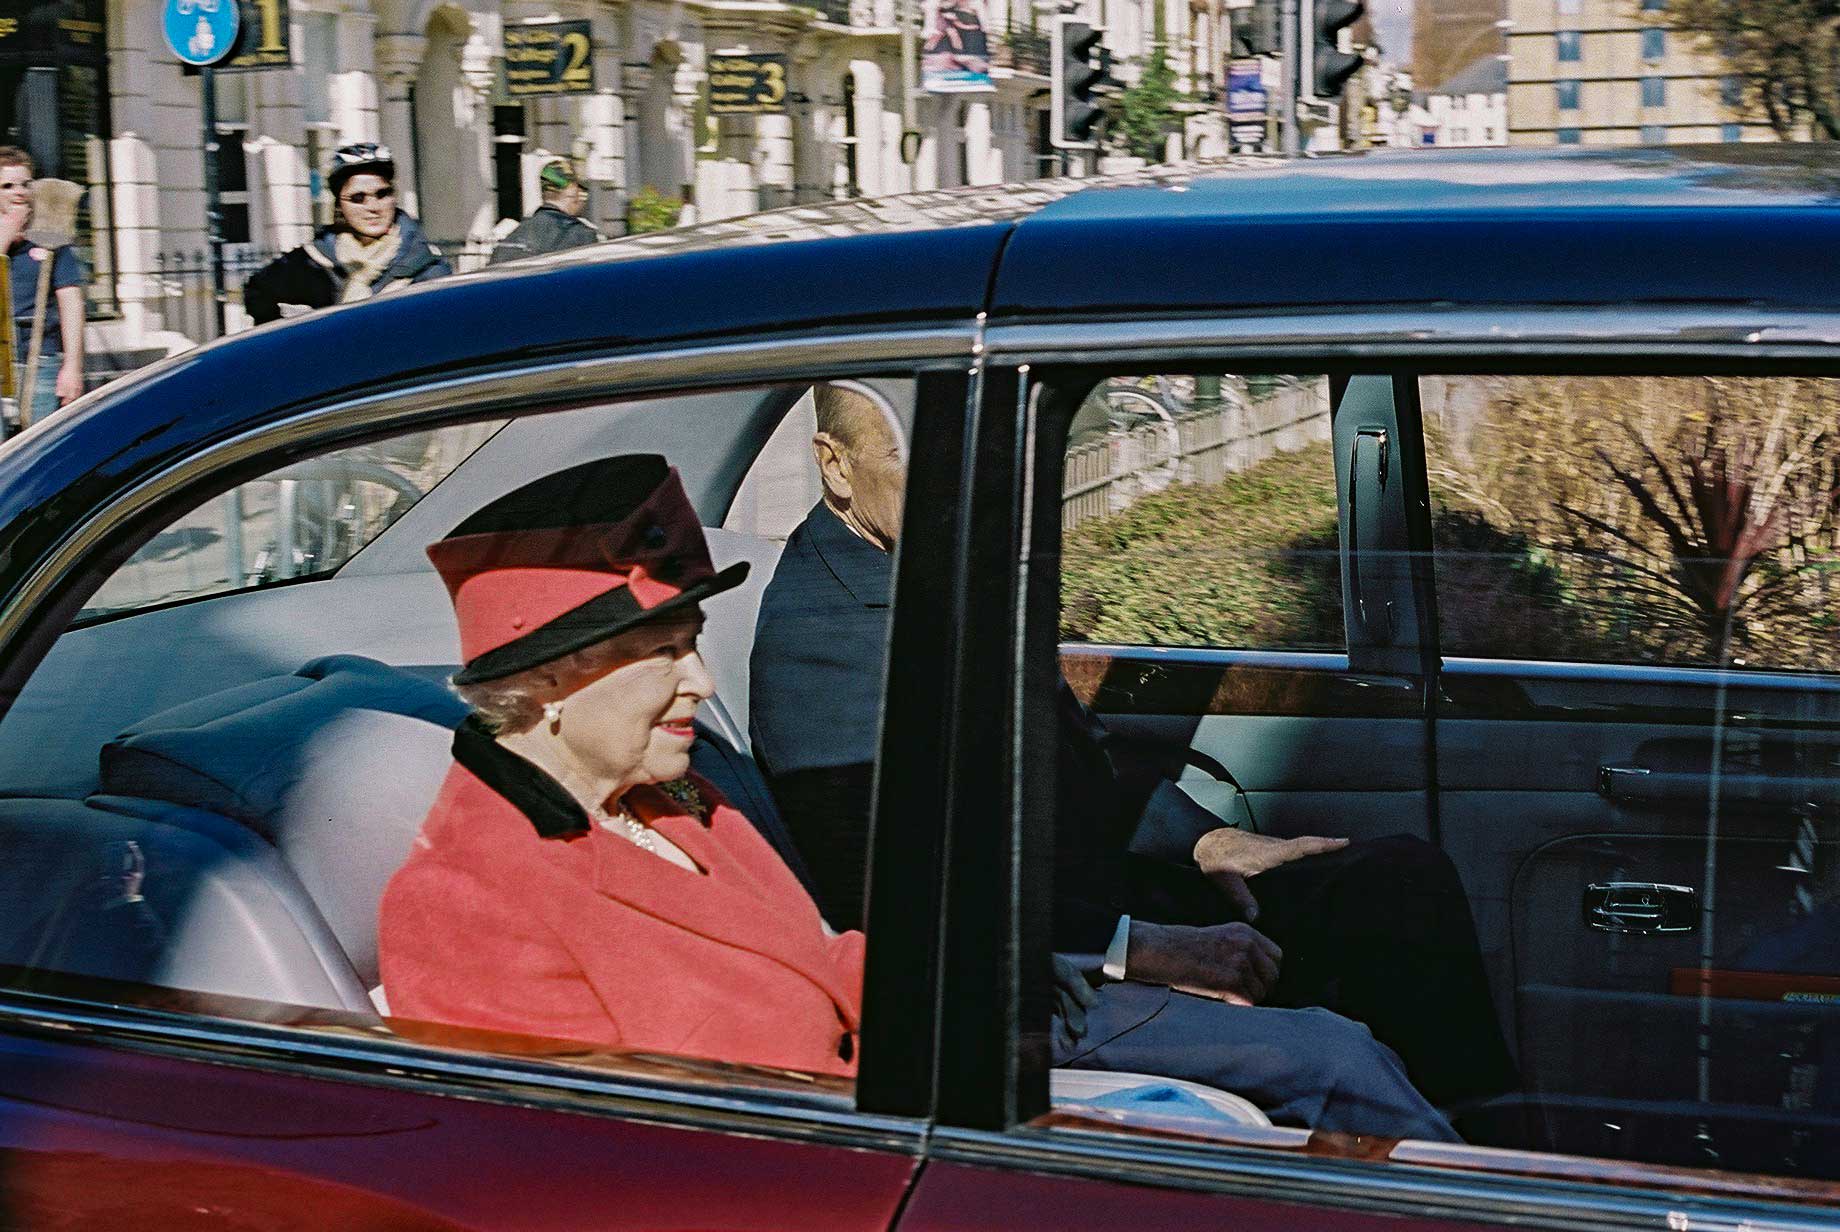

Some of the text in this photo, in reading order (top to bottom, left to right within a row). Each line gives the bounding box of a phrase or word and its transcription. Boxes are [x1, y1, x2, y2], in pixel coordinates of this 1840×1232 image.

[255, 0, 287, 51] 1
[560, 32, 591, 80] 2
[757, 62, 785, 103] 3
